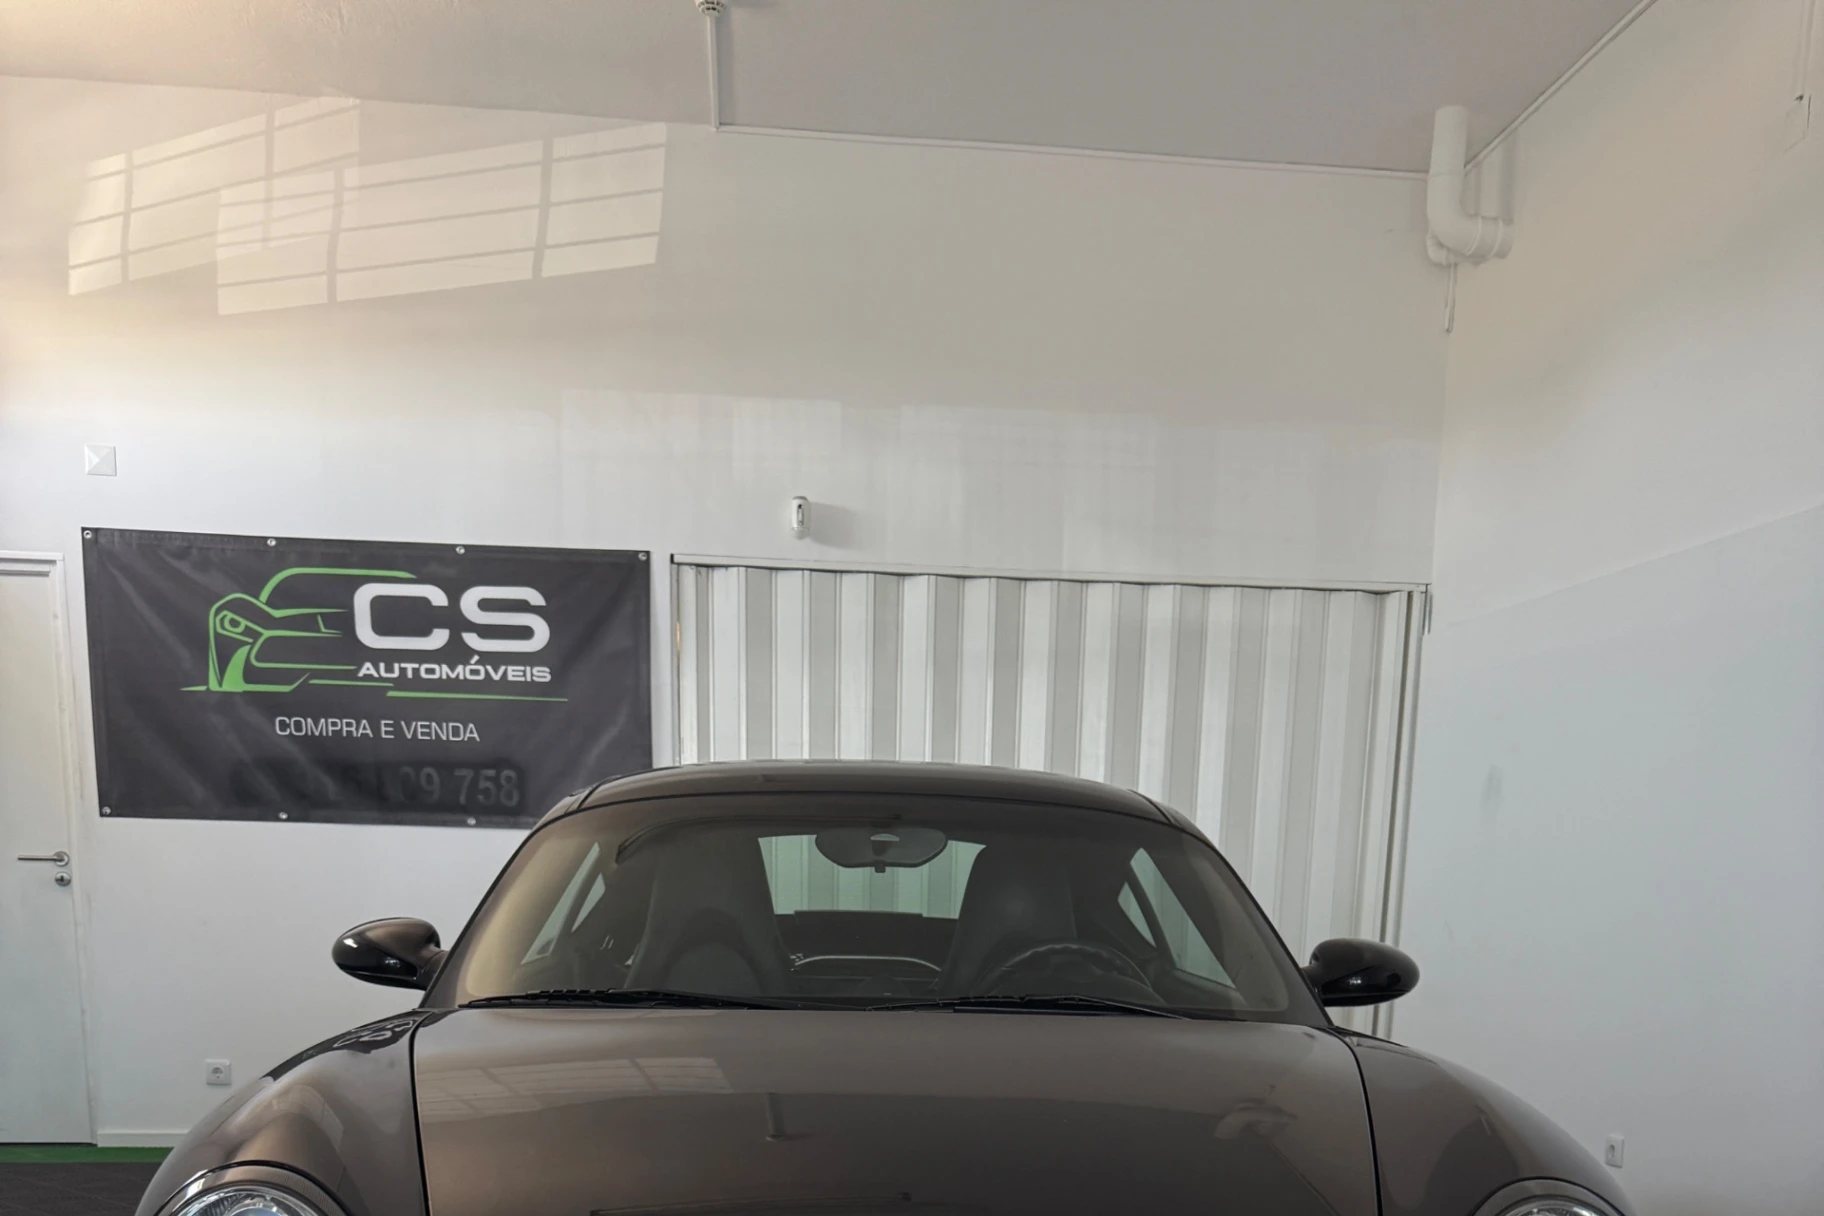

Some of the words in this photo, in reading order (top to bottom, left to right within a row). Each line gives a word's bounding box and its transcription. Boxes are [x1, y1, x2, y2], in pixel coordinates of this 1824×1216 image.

[353, 582, 551, 653] CS
[357, 655, 552, 683] AUTOMÓVEIS
[275, 716, 374, 738] COMPRA
[380, 719, 395, 739] E
[400, 720, 481, 742] VENDA
[453, 768, 521, 808] 758
